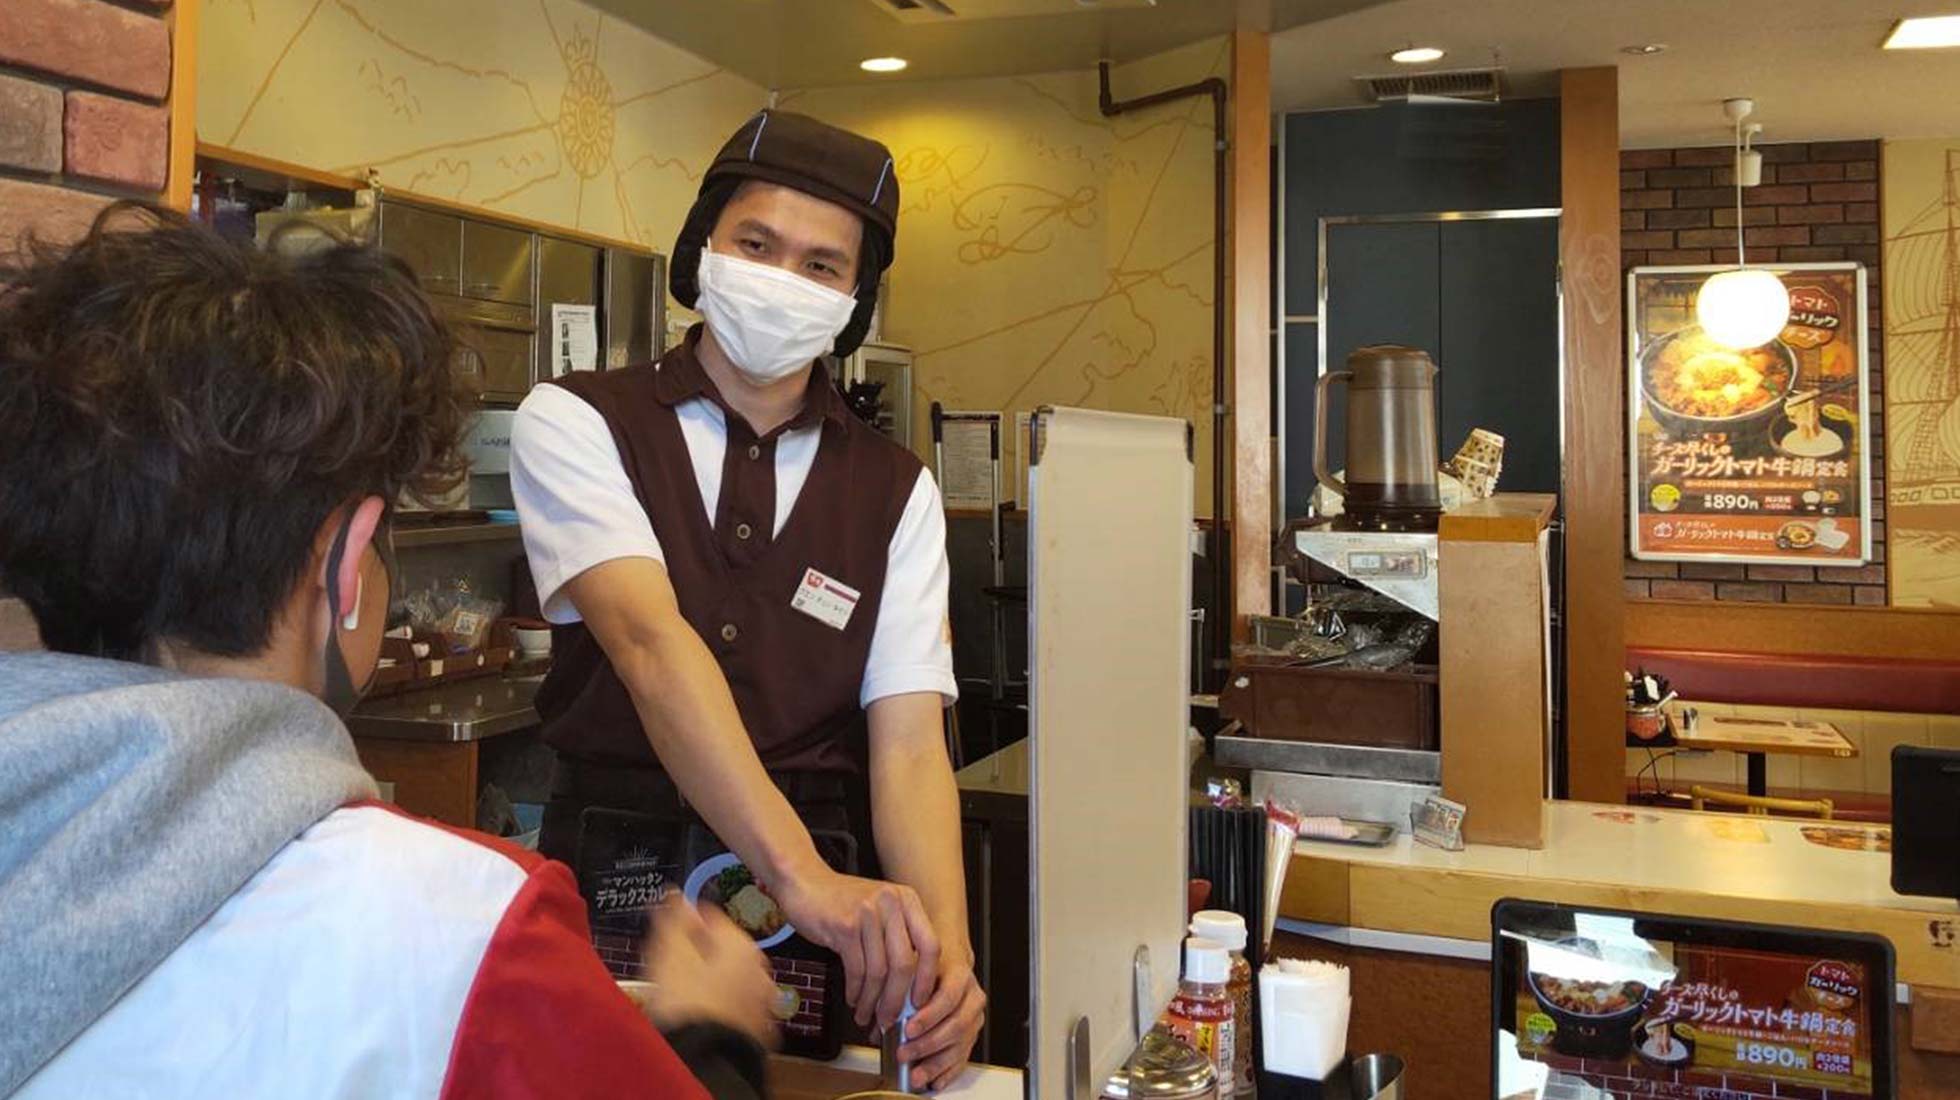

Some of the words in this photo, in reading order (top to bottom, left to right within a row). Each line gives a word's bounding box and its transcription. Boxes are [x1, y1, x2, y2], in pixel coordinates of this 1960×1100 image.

[1790, 295, 1828, 310] トマト
[1787, 312, 1839, 328] ーリック
[1661, 981, 1739, 1000] チーズ尽くしの
[1660, 997, 1857, 1038] ガーリックトマト牛鍋定食
